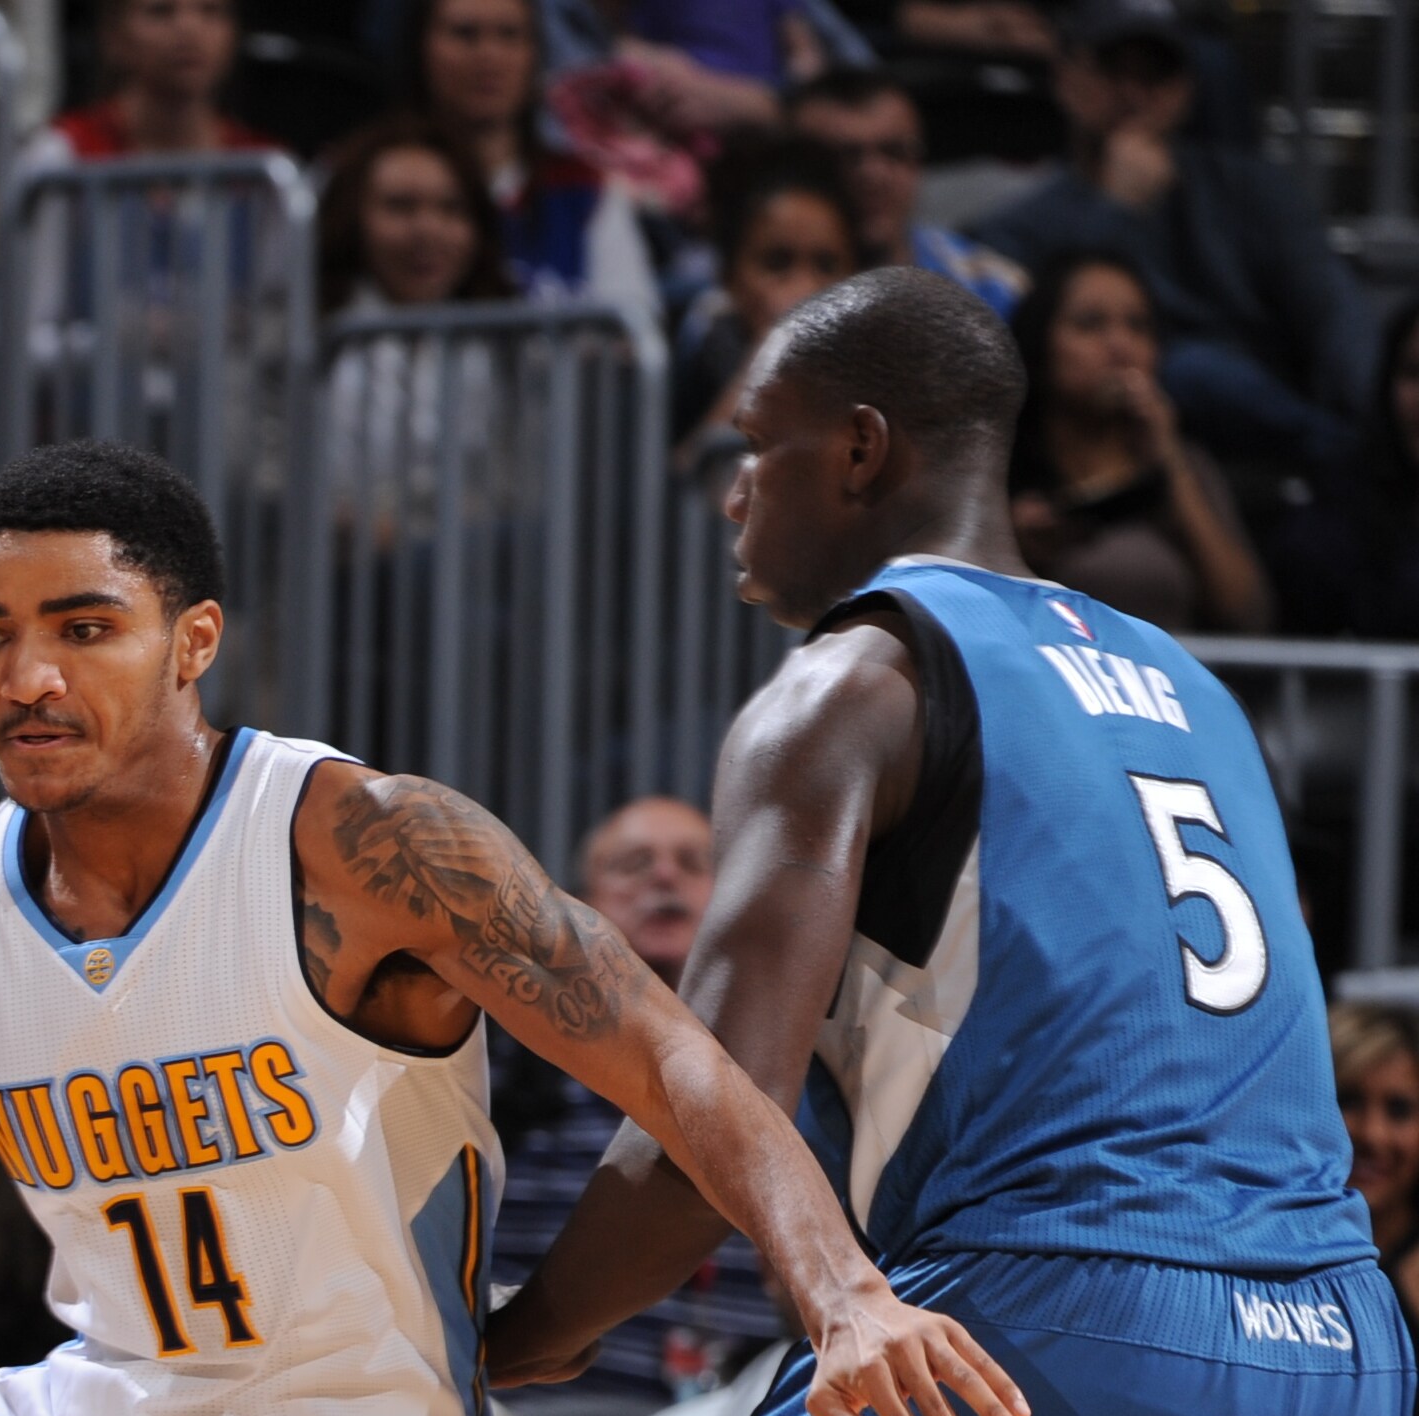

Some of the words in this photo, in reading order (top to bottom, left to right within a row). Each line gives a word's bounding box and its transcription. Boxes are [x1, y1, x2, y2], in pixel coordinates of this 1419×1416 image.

[1037, 643, 1191, 733] DIENG
[1126, 771, 1270, 1017] 5
[100, 1186, 264, 1358] 14
[1233, 1290, 1354, 1351] WOLVES
